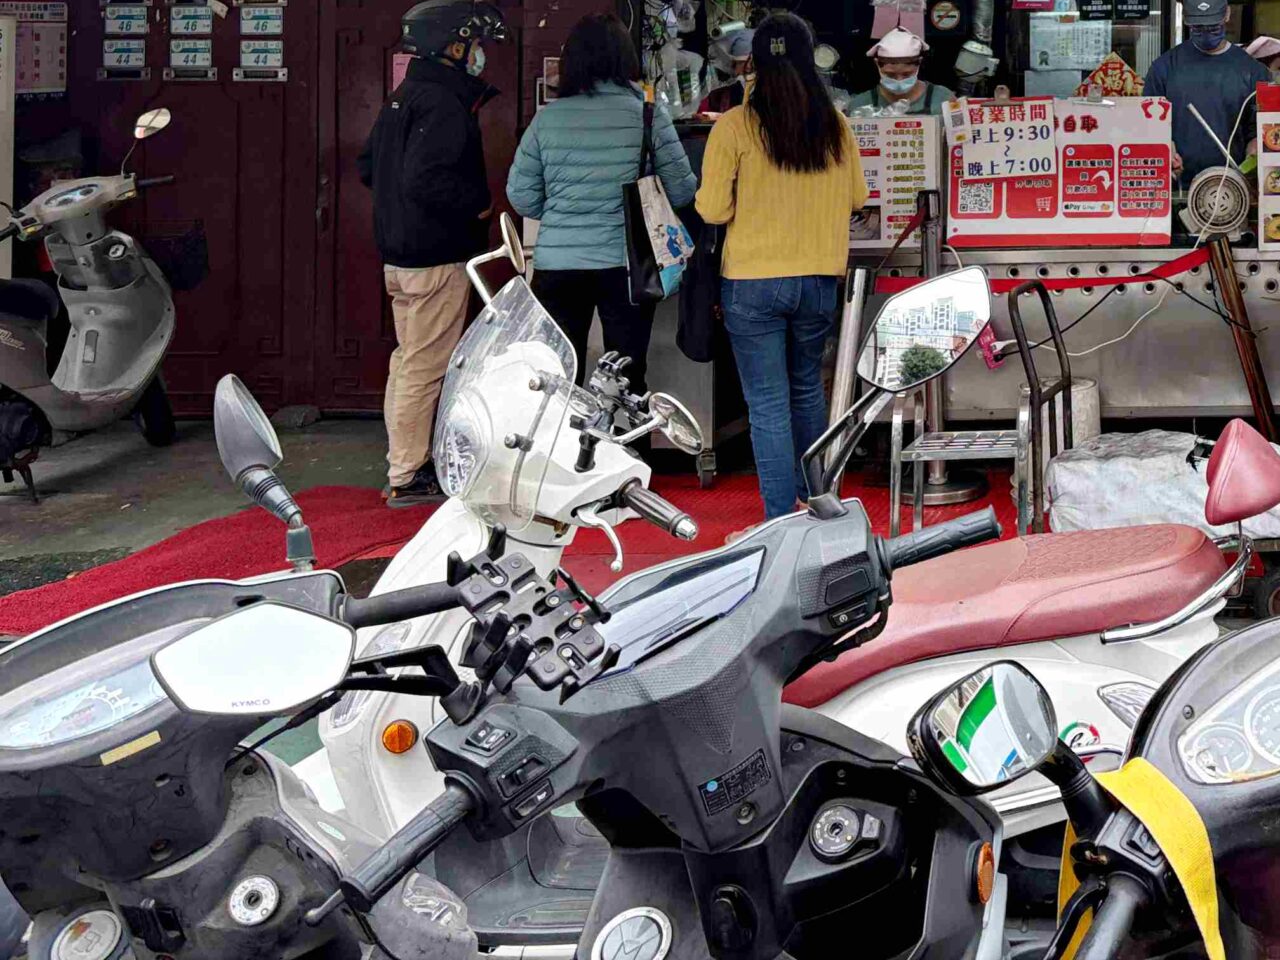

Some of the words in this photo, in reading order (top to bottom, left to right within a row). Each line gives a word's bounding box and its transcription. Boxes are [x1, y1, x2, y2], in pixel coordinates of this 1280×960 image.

[118, 21, 131, 31] 46
[184, 21, 197, 31] 46
[253, 21, 268, 31] 46
[116, 54, 130, 64] 44
[183, 54, 197, 64] 44
[254, 54, 268, 64] 44
[968, 103, 1047, 125] 營業時間
[1053, 113, 1099, 133] 自取
[1003, 124, 1050, 142] 9:30
[856, 136, 877, 147] 5元
[967, 160, 1001, 176] 晚上
[1005, 157, 1052, 174] 7:00
[231, 698, 271, 708] KYMCO
